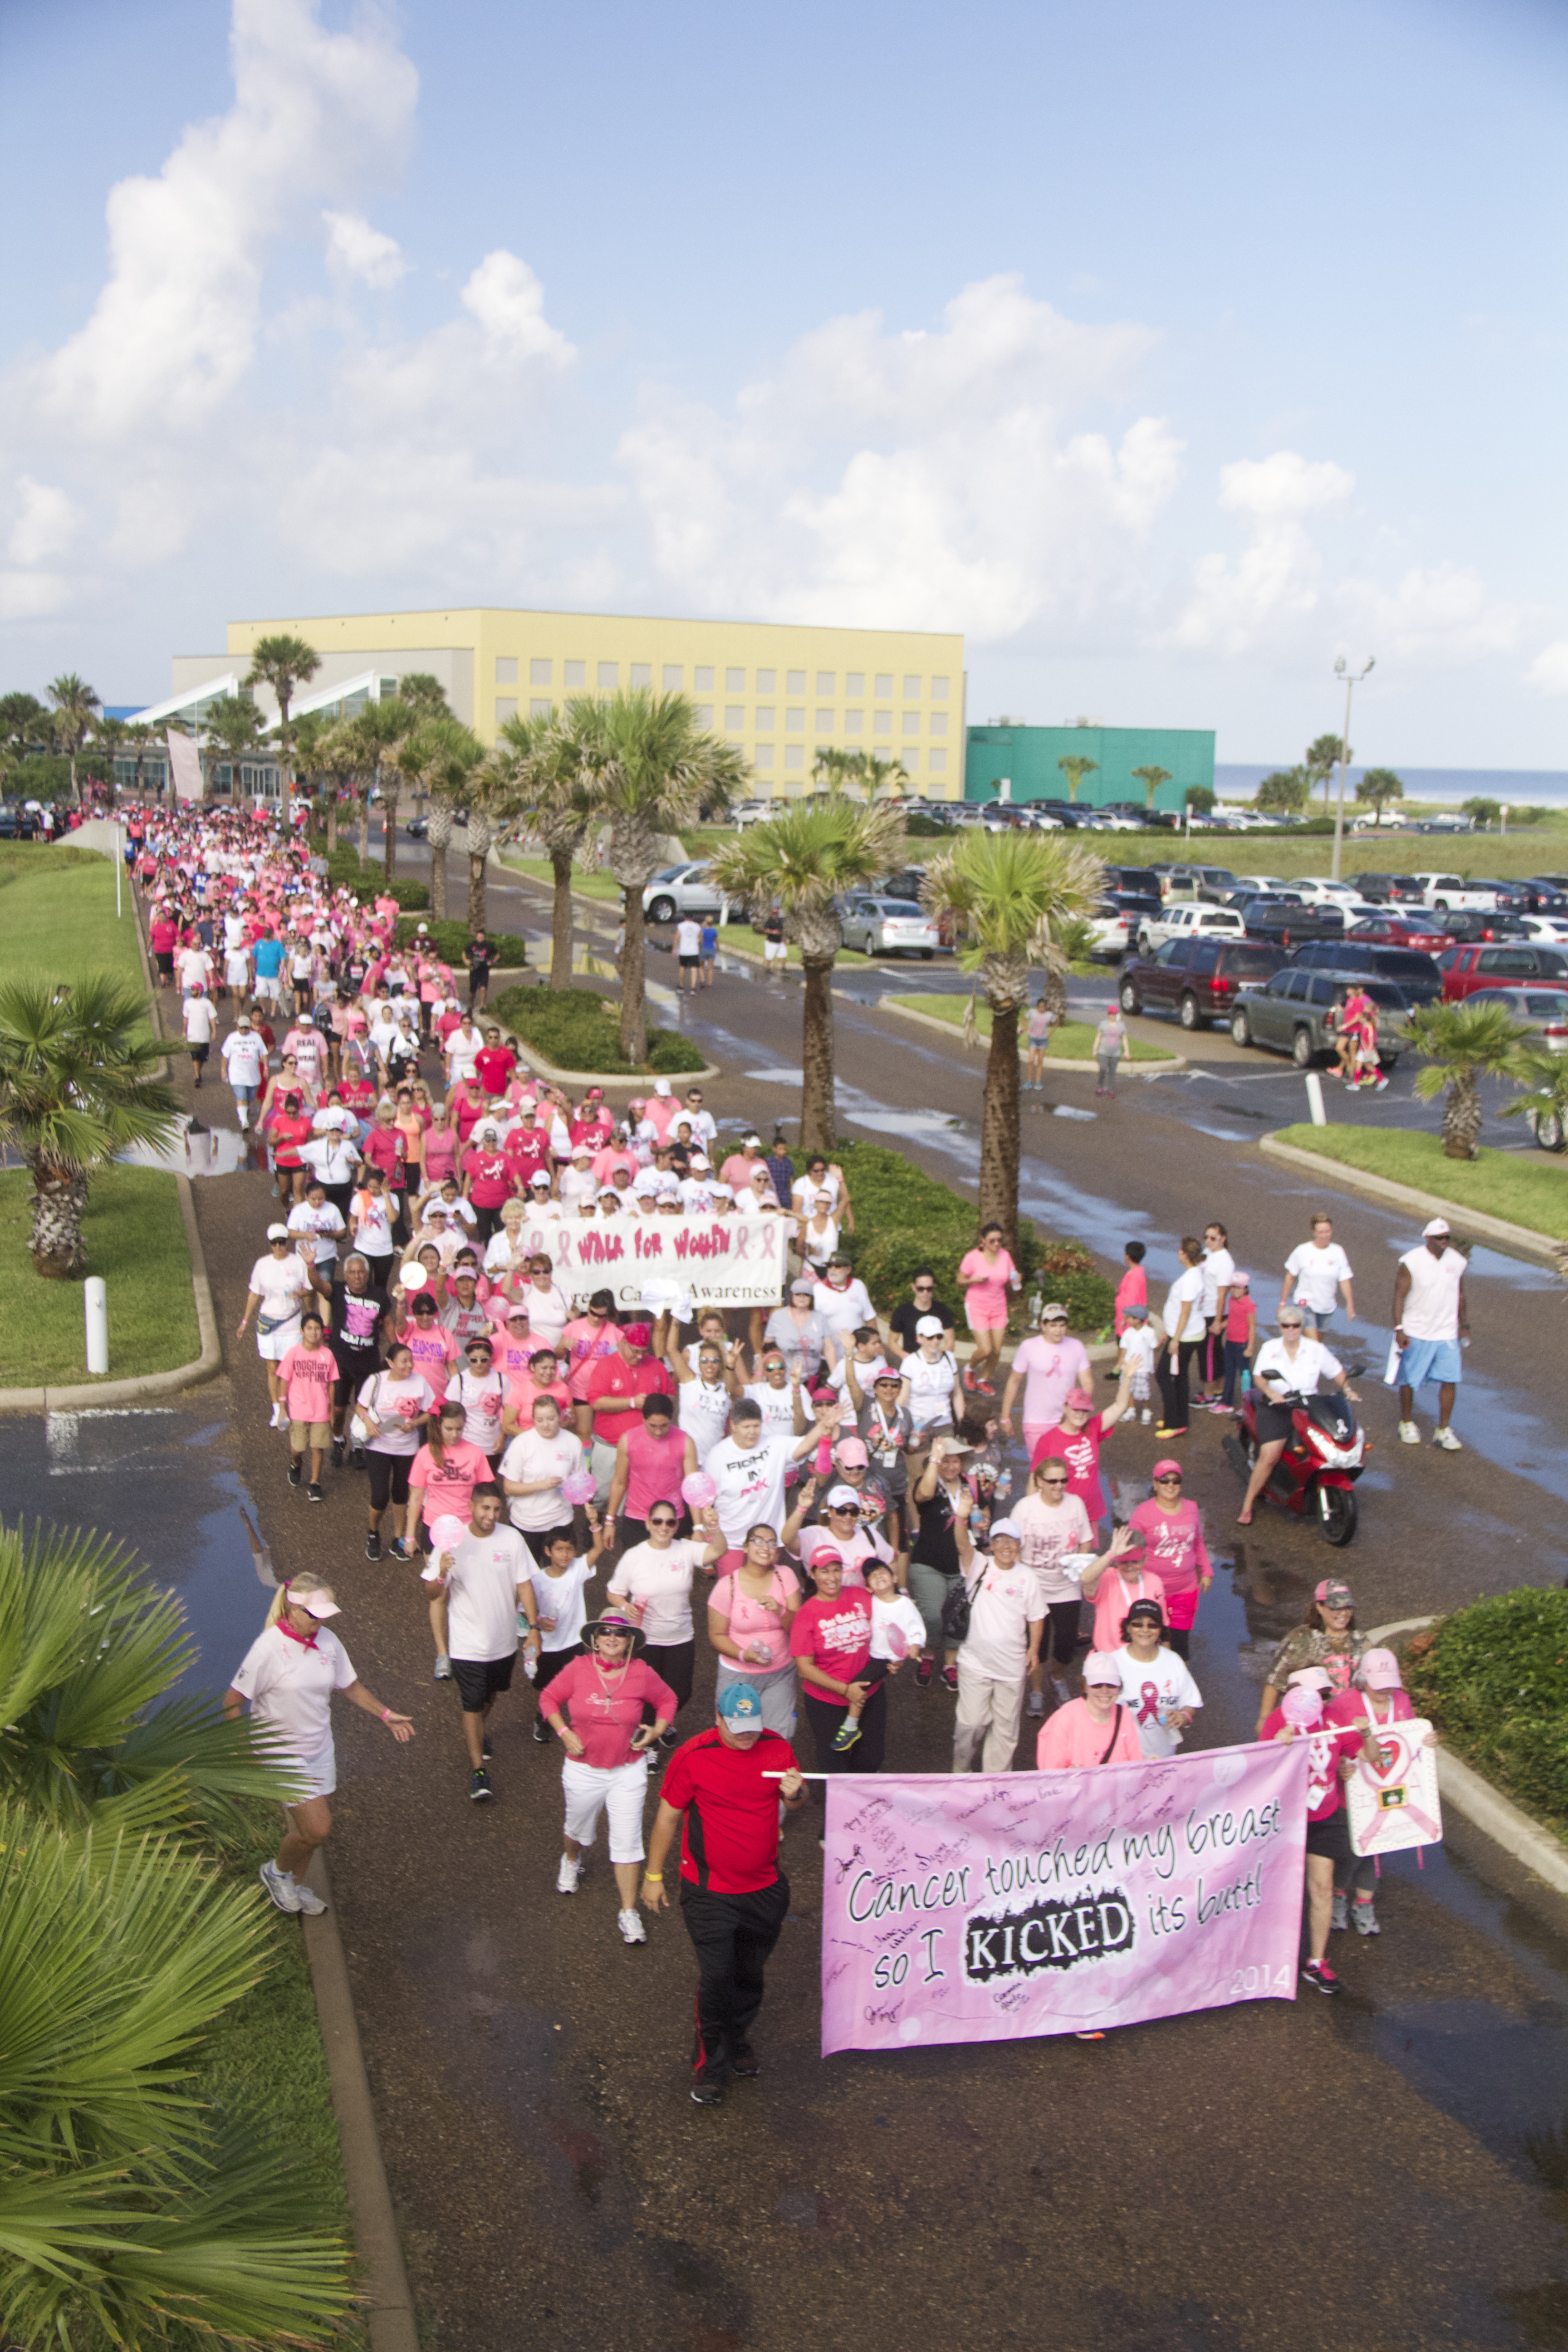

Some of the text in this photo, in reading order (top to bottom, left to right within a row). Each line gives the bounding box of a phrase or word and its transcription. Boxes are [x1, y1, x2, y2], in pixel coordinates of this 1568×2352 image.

[578, 1230, 624, 1265] WALK
[689, 1283, 776, 1299] Awareness
[849, 1866, 971, 1921] Cancer
[986, 1828, 1116, 1895] touched
[1124, 1825, 1174, 1878] my
[1186, 1798, 1280, 1854] breast
[874, 1954, 907, 1988] so
[921, 1930, 945, 1982] I
[969, 1902, 1130, 1970] KICKED
[1148, 1893, 1185, 1936] its
[1198, 1862, 1263, 1924] butt!
[1230, 1964, 1291, 1995] 2014
